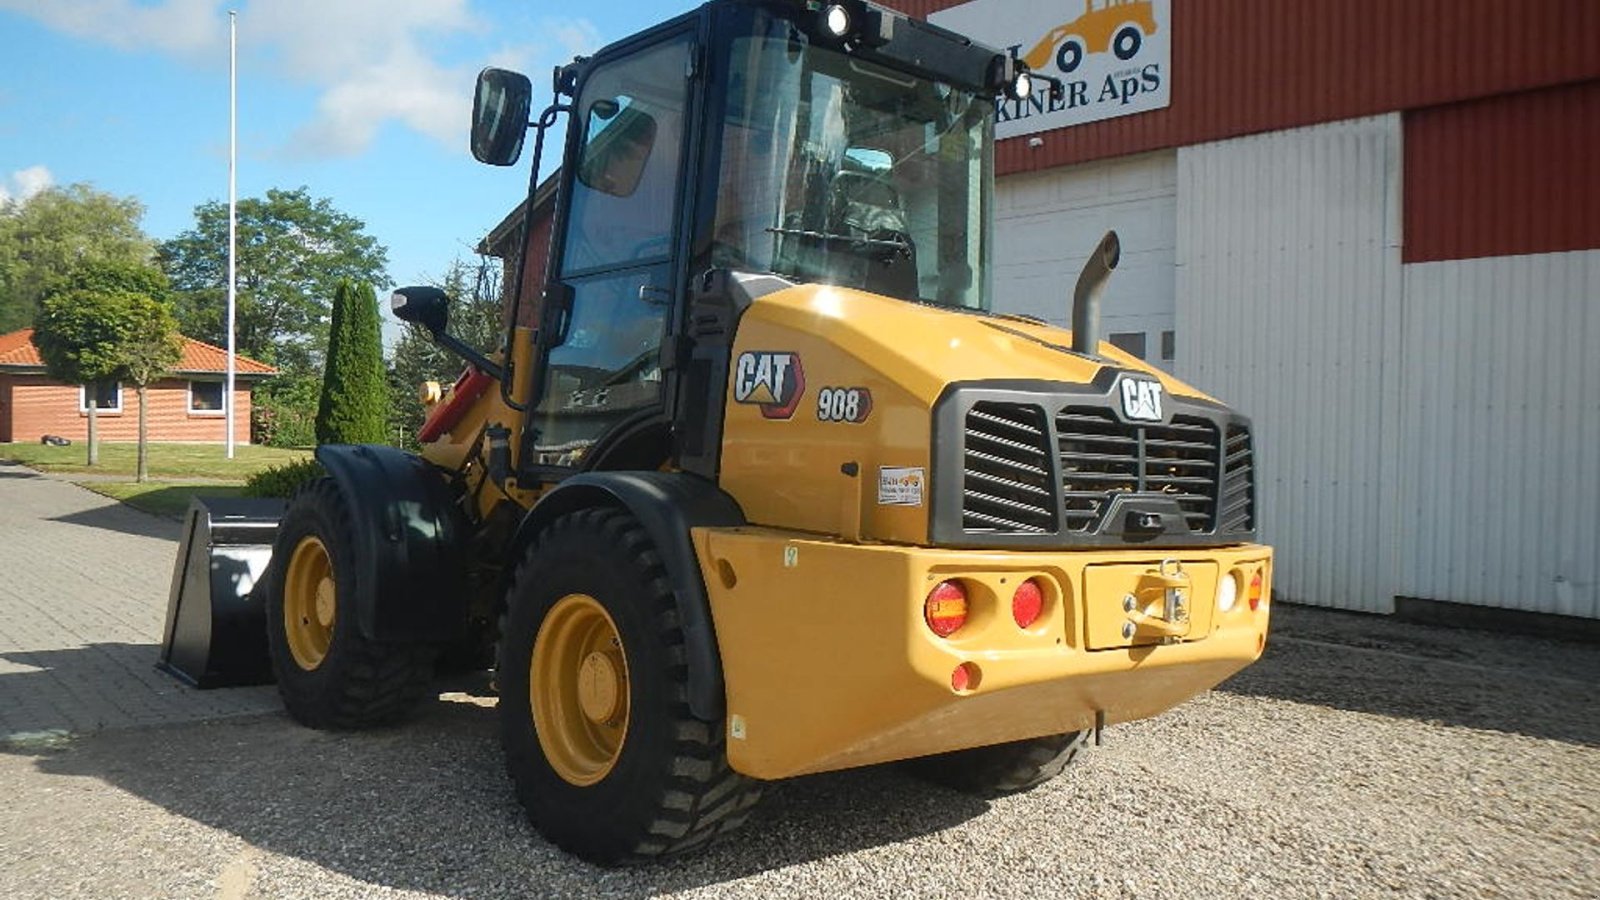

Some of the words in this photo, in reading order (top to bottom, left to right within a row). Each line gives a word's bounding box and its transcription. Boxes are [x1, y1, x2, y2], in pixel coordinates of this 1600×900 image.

[1097, 63, 1160, 105] ApS
[735, 353, 791, 402] CAT
[818, 389, 859, 420] 908
[1121, 378, 1162, 420] CAT
